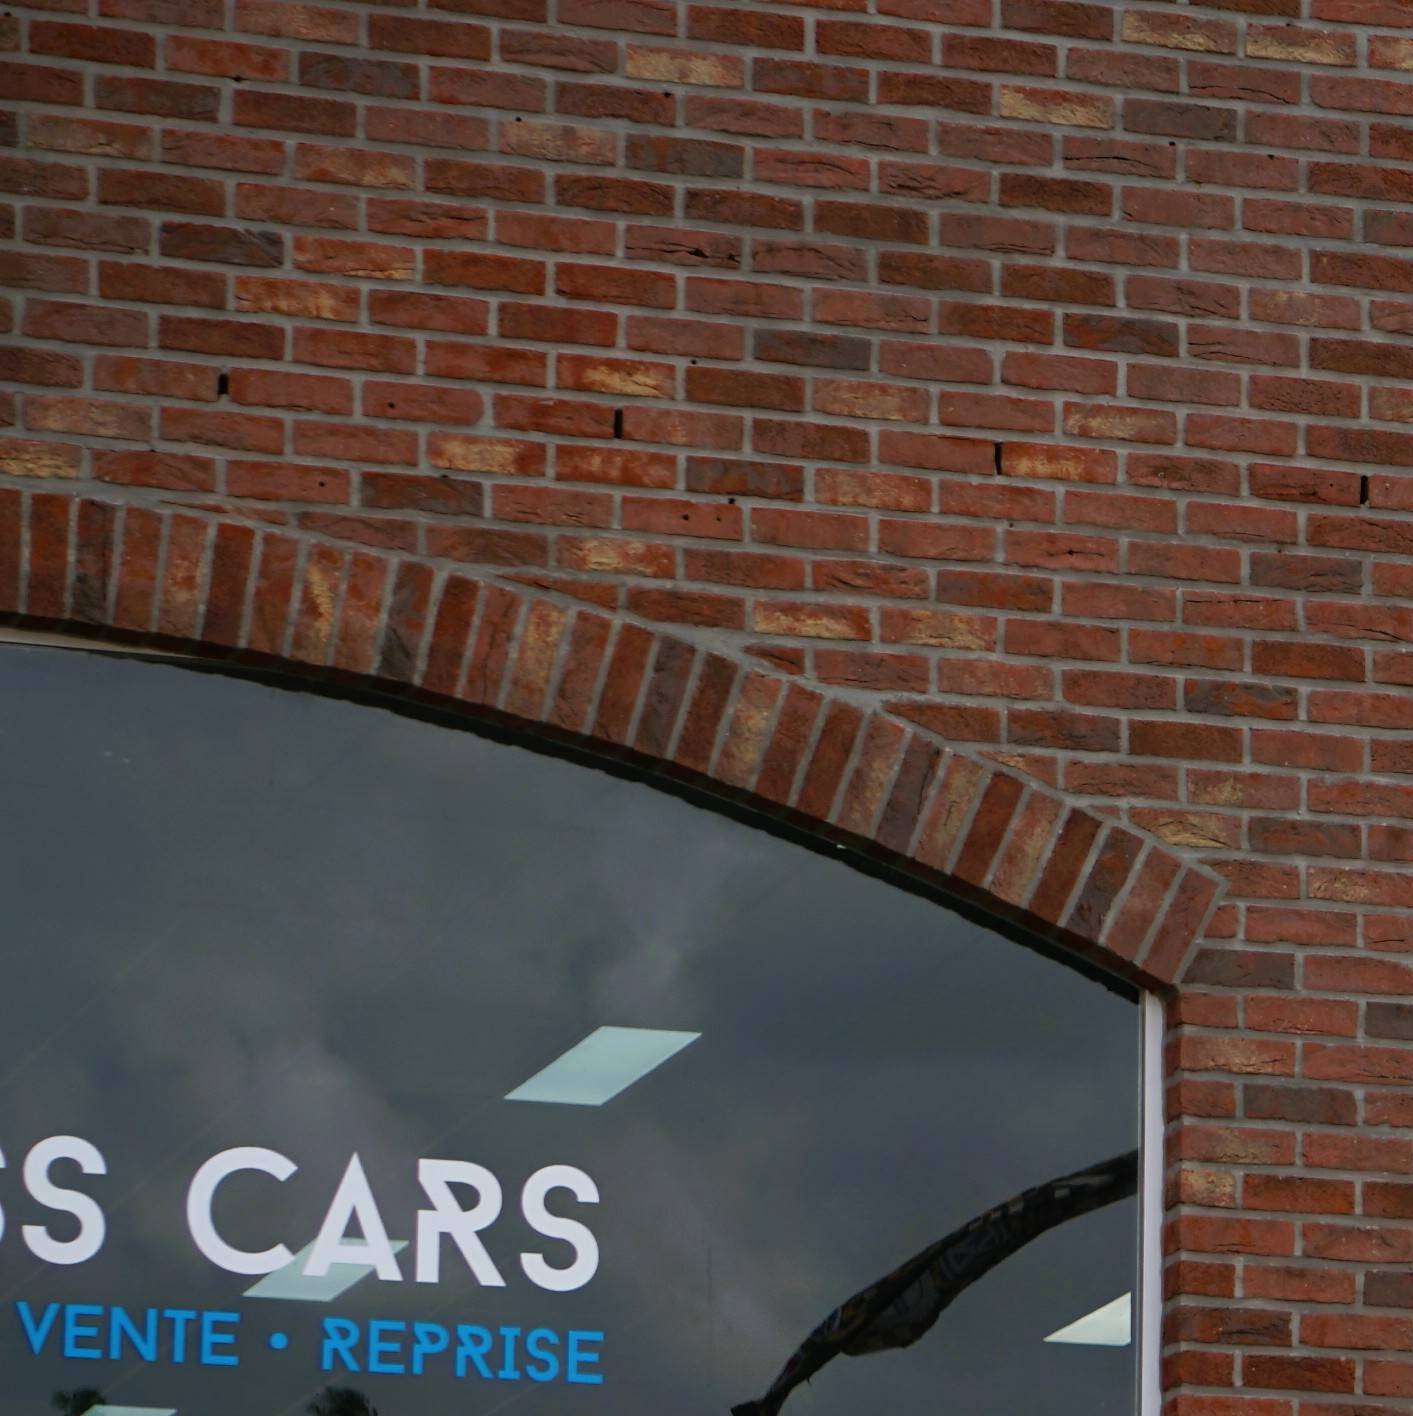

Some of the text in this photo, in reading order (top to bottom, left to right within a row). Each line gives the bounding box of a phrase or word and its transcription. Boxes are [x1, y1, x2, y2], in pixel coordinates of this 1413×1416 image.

[0, 1134, 601, 1292] S CARS
[16, 1301, 605, 1384] VENTE REPRISE
